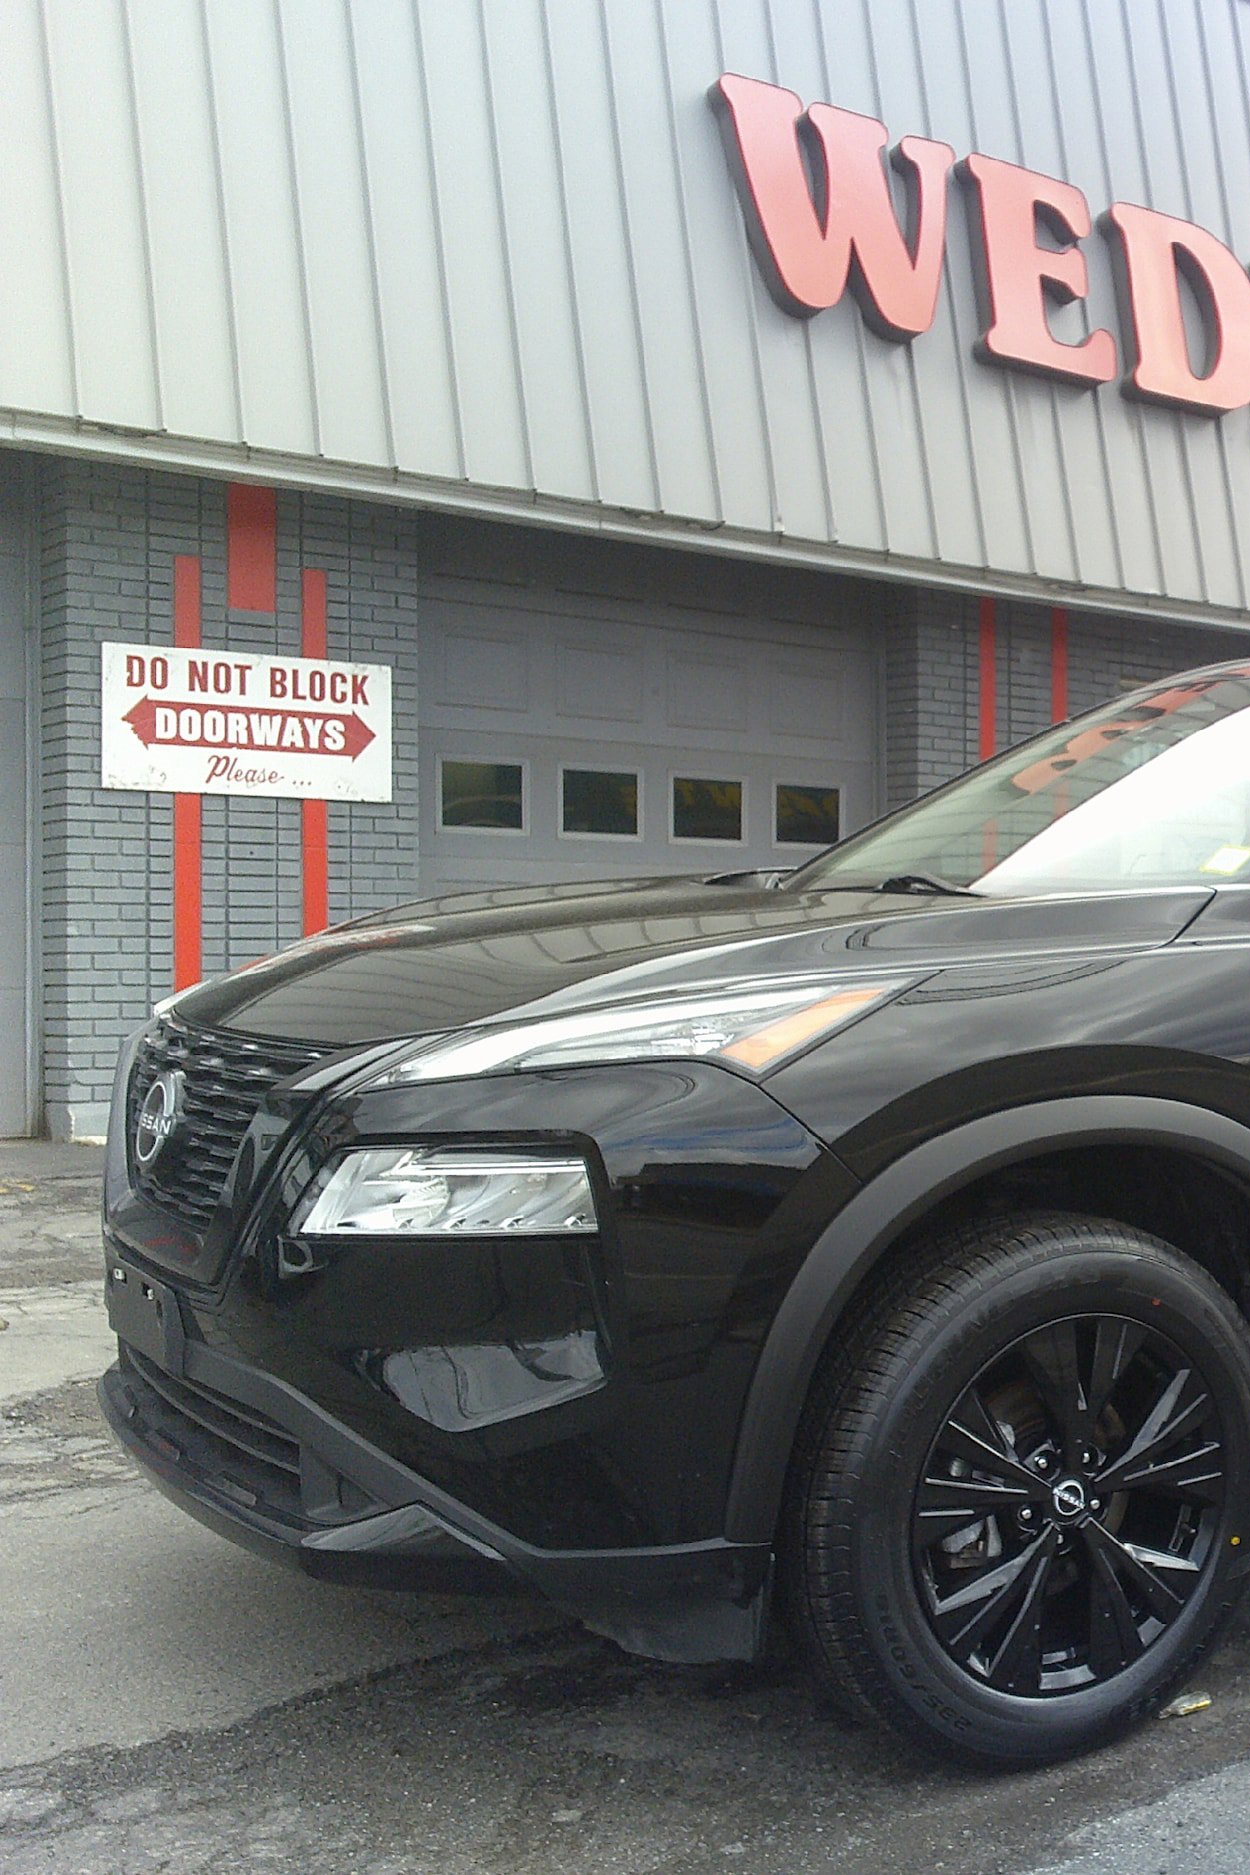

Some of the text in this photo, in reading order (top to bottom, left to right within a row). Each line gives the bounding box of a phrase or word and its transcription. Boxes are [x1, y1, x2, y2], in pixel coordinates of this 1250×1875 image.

[126, 655, 370, 706] DO NOT BLOCK
[155, 707, 346, 751] DOORWAYS
